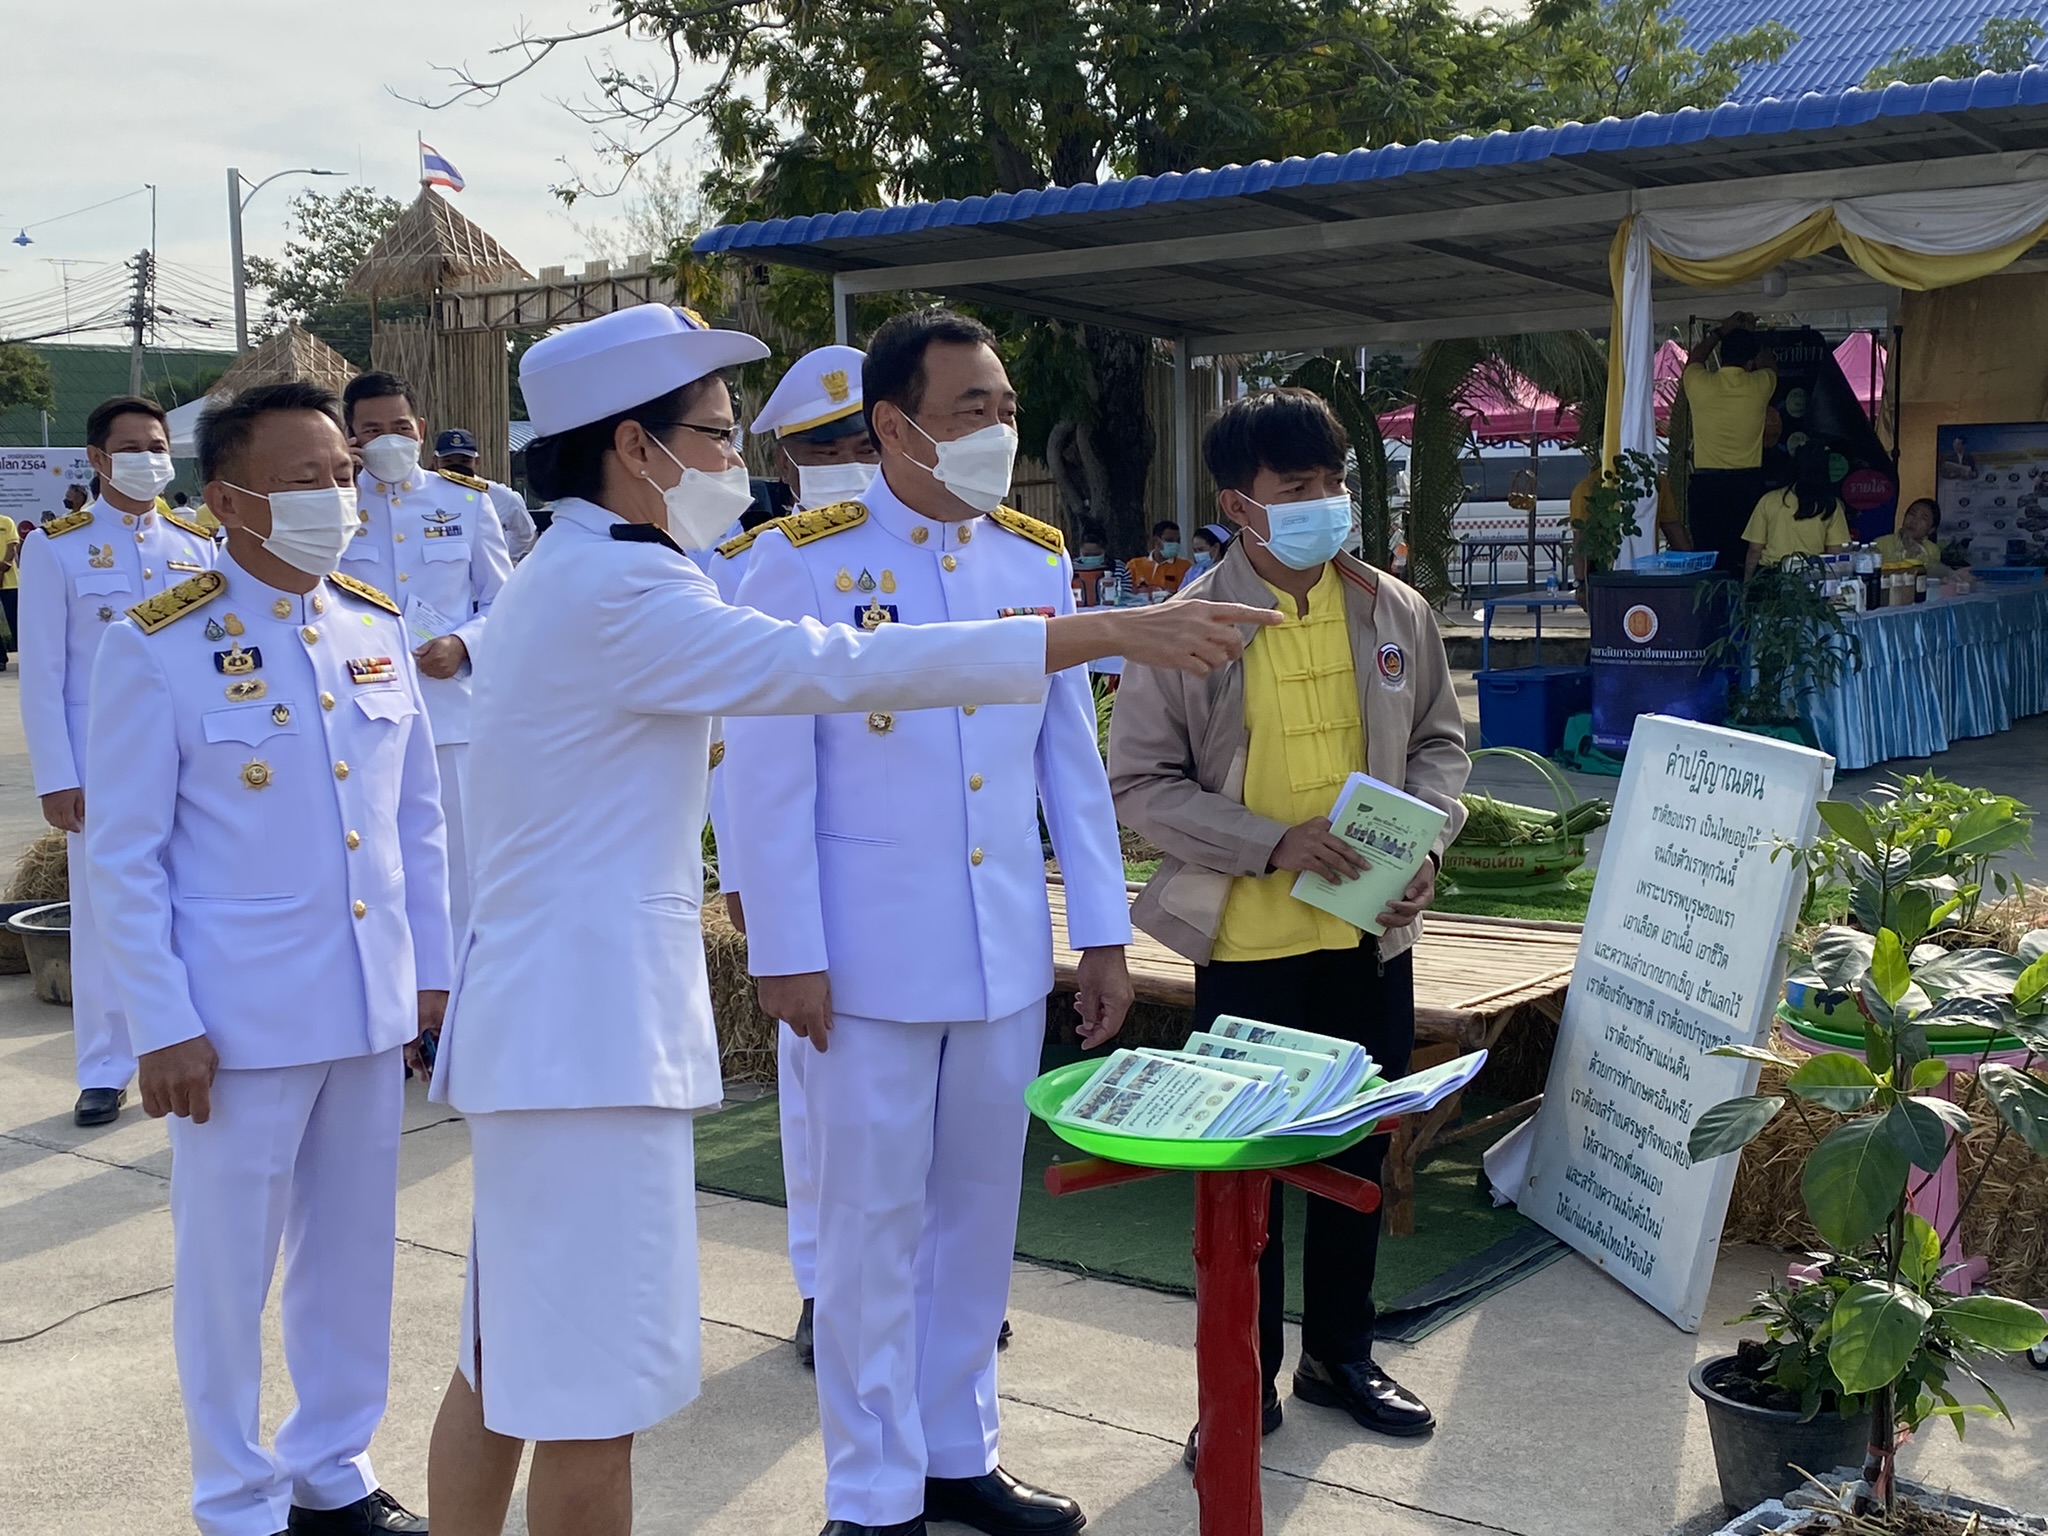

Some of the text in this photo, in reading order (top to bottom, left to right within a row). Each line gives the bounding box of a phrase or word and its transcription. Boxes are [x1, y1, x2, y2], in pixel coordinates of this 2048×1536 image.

[21, 459, 47, 470] 2564
[1850, 479, 1887, 494] รายได้
[1666, 744, 1765, 800] คำปฏิญาณตน
[1652, 803, 1697, 833] ชาติของเรา
[1654, 843, 1740, 887] จนถึงตัวเราทุกวันนี้
[1636, 878, 1736, 929] เพราะบรรพบุรุษของเรา
[1623, 913, 1730, 970] เอาเลือด เอาเนื้อ เอาชีวิต
[1586, 975, 1656, 1020] เราต้องรักษาชาติ
[1593, 941, 1744, 1018] และความลำบากยากเข็ญ เข้าแลกไว้
[1605, 1024, 1691, 1081] เราต้องรักษาแผ่นดิน
[1588, 1050, 1693, 1125] ด้วยการทำเกษตรอินทรีย์
[1571, 1088, 1692, 1170] เราต้องสร้างเศรษฐกิจพอเพียง
[1582, 1125, 1664, 1196] ให้สามารถพึ่งตนเอง
[1565, 1165, 1665, 1240] และสร้างความมั่งคั่งใหม่
[1556, 1191, 1656, 1279] ให้แก่แผ่นดินไทยให้จงได้
